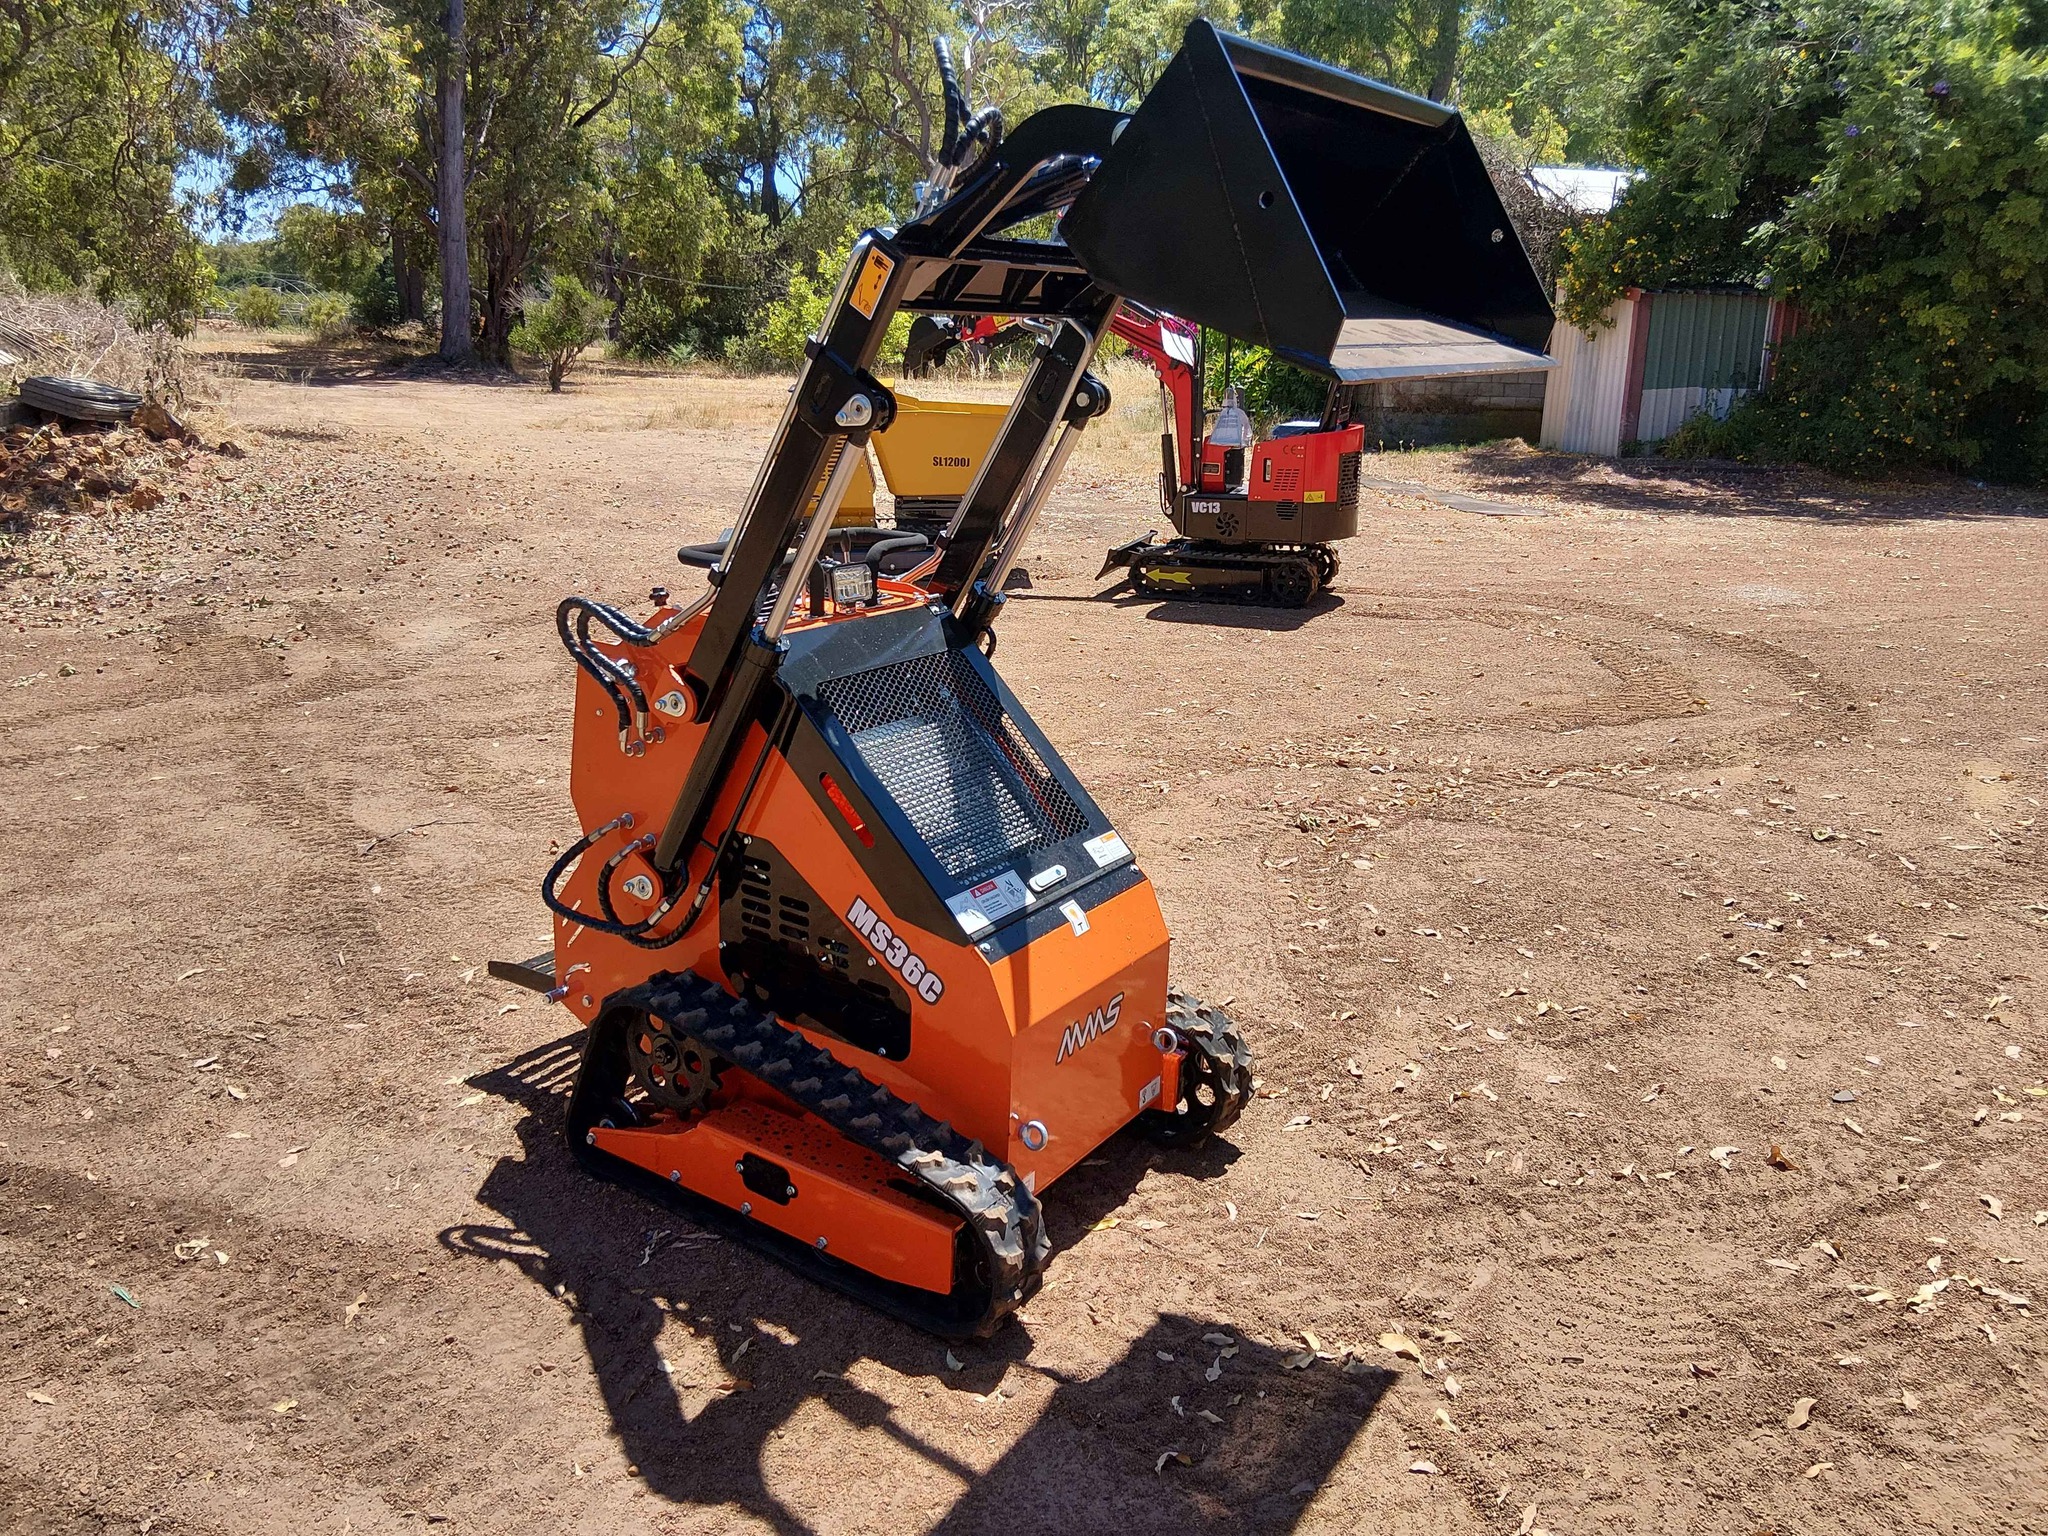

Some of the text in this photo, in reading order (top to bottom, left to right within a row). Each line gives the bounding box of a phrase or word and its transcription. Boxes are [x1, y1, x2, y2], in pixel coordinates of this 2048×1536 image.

[932, 456, 971, 467] SL1200J
[1191, 501, 1221, 514] VC13
[846, 895, 944, 1005] MS36C
